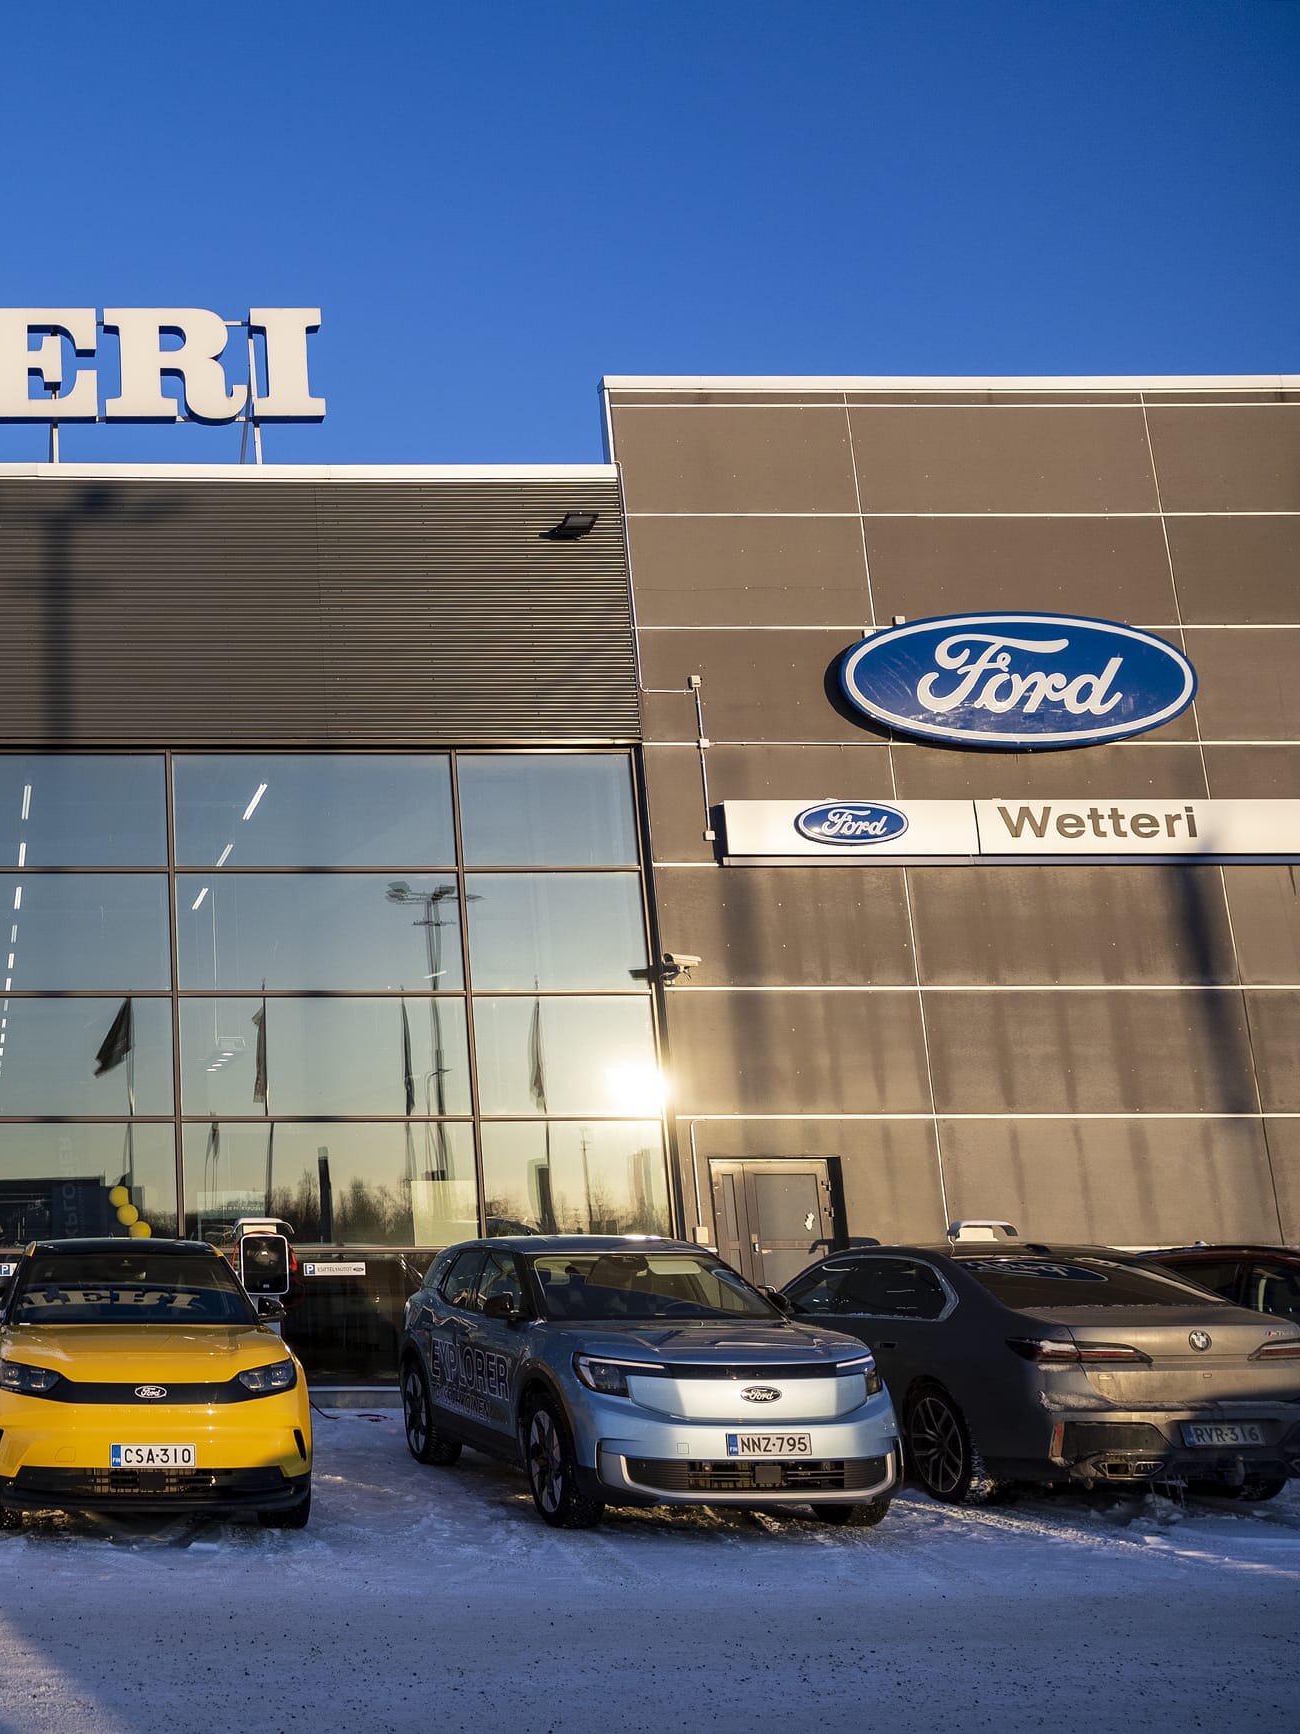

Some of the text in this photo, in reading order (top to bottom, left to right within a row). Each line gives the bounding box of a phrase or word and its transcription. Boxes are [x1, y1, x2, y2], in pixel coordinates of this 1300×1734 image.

[917, 634, 1123, 715] Ford
[821, 808, 888, 837] Ford
[997, 806, 1198, 839] Wetteri
[431, 1338, 509, 1401] EXPLORER
[748, 1389, 774, 1400] Ford
[741, 1437, 808, 1453] NNZ-795
[1193, 1425, 1260, 1443] RVR-316
[124, 1448, 191, 1464] CSA-310
